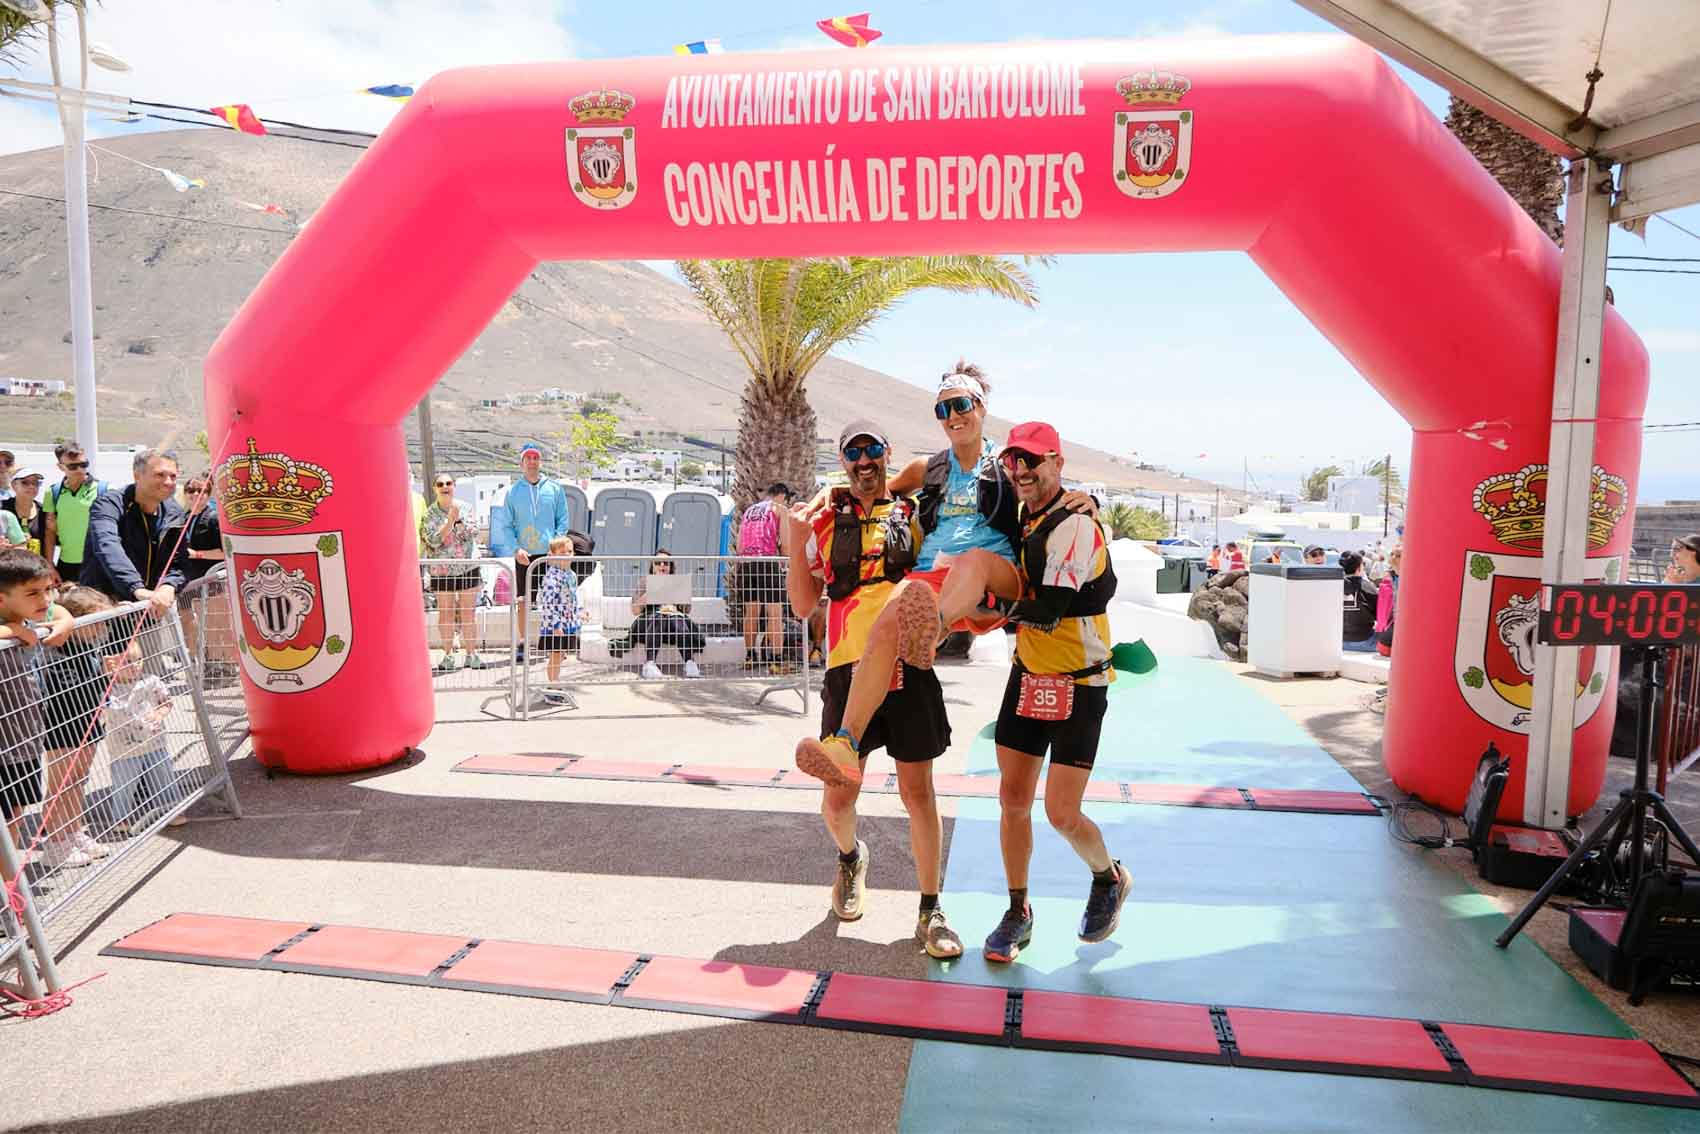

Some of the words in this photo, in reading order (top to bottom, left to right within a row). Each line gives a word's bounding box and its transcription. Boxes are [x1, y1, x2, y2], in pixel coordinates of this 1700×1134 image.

[661, 69, 843, 128] AYUNTAMIENTO
[848, 67, 879, 122] DE
[883, 64, 933, 122] SAN
[663, 143, 861, 227] CONCEJALÍA
[866, 157, 909, 222] DE
[916, 151, 1085, 222] DEPORTES
[1553, 591, 1700, 639] 04:08:
[1033, 689, 1057, 706] 35
